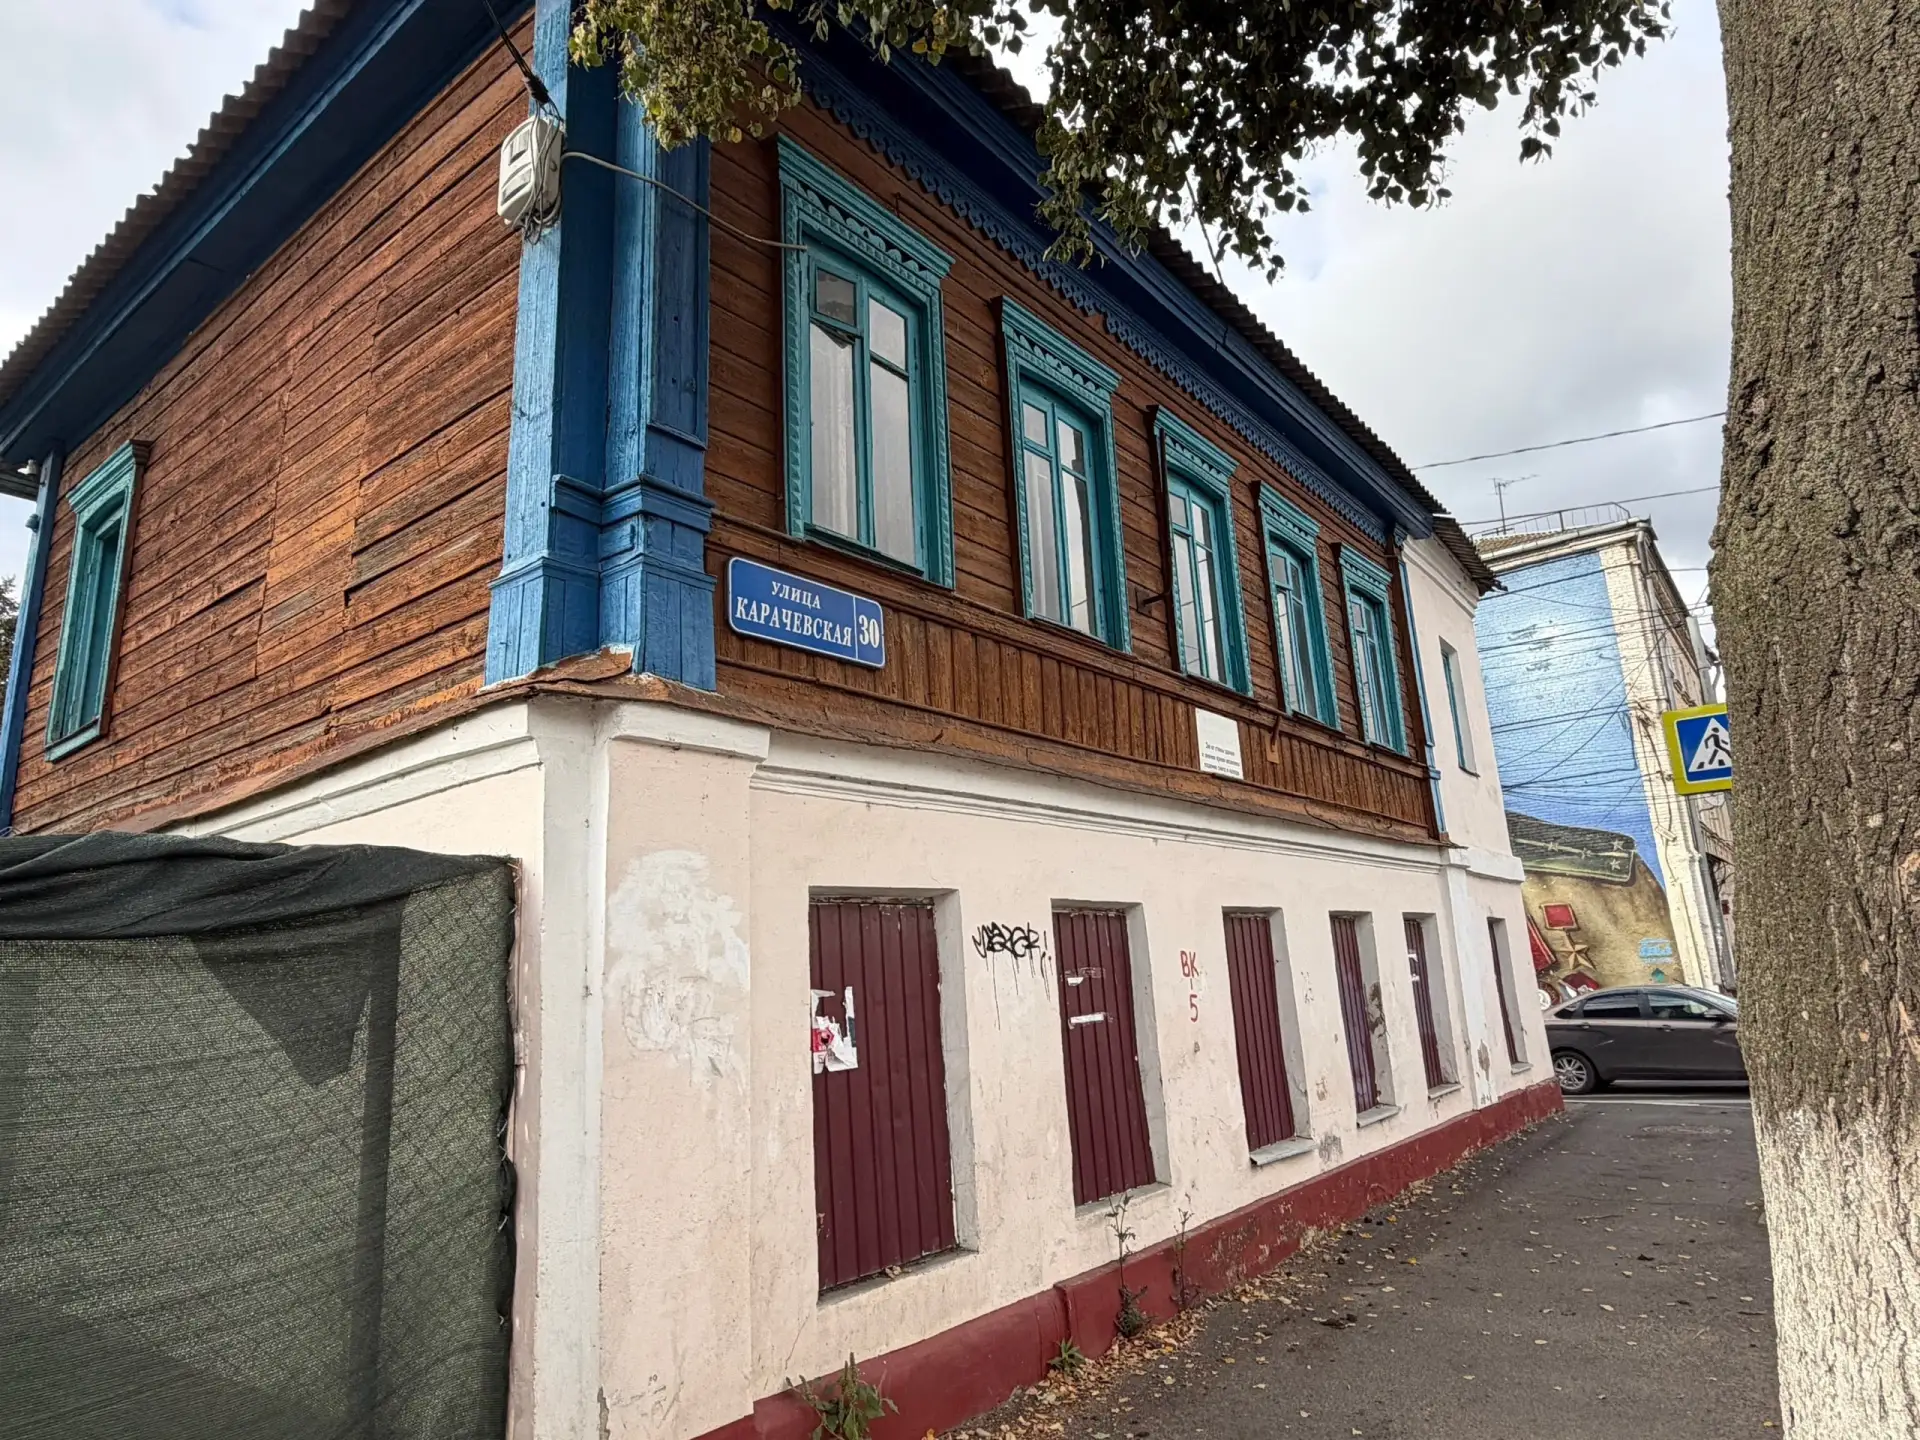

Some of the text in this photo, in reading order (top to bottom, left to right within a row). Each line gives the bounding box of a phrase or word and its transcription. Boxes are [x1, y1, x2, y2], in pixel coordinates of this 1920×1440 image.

[771, 581, 821, 610] УЛИЦА
[735, 596, 880, 649] КАРАЧЕВСКАЯ 30
[1189, 994, 1199, 1023] 5
